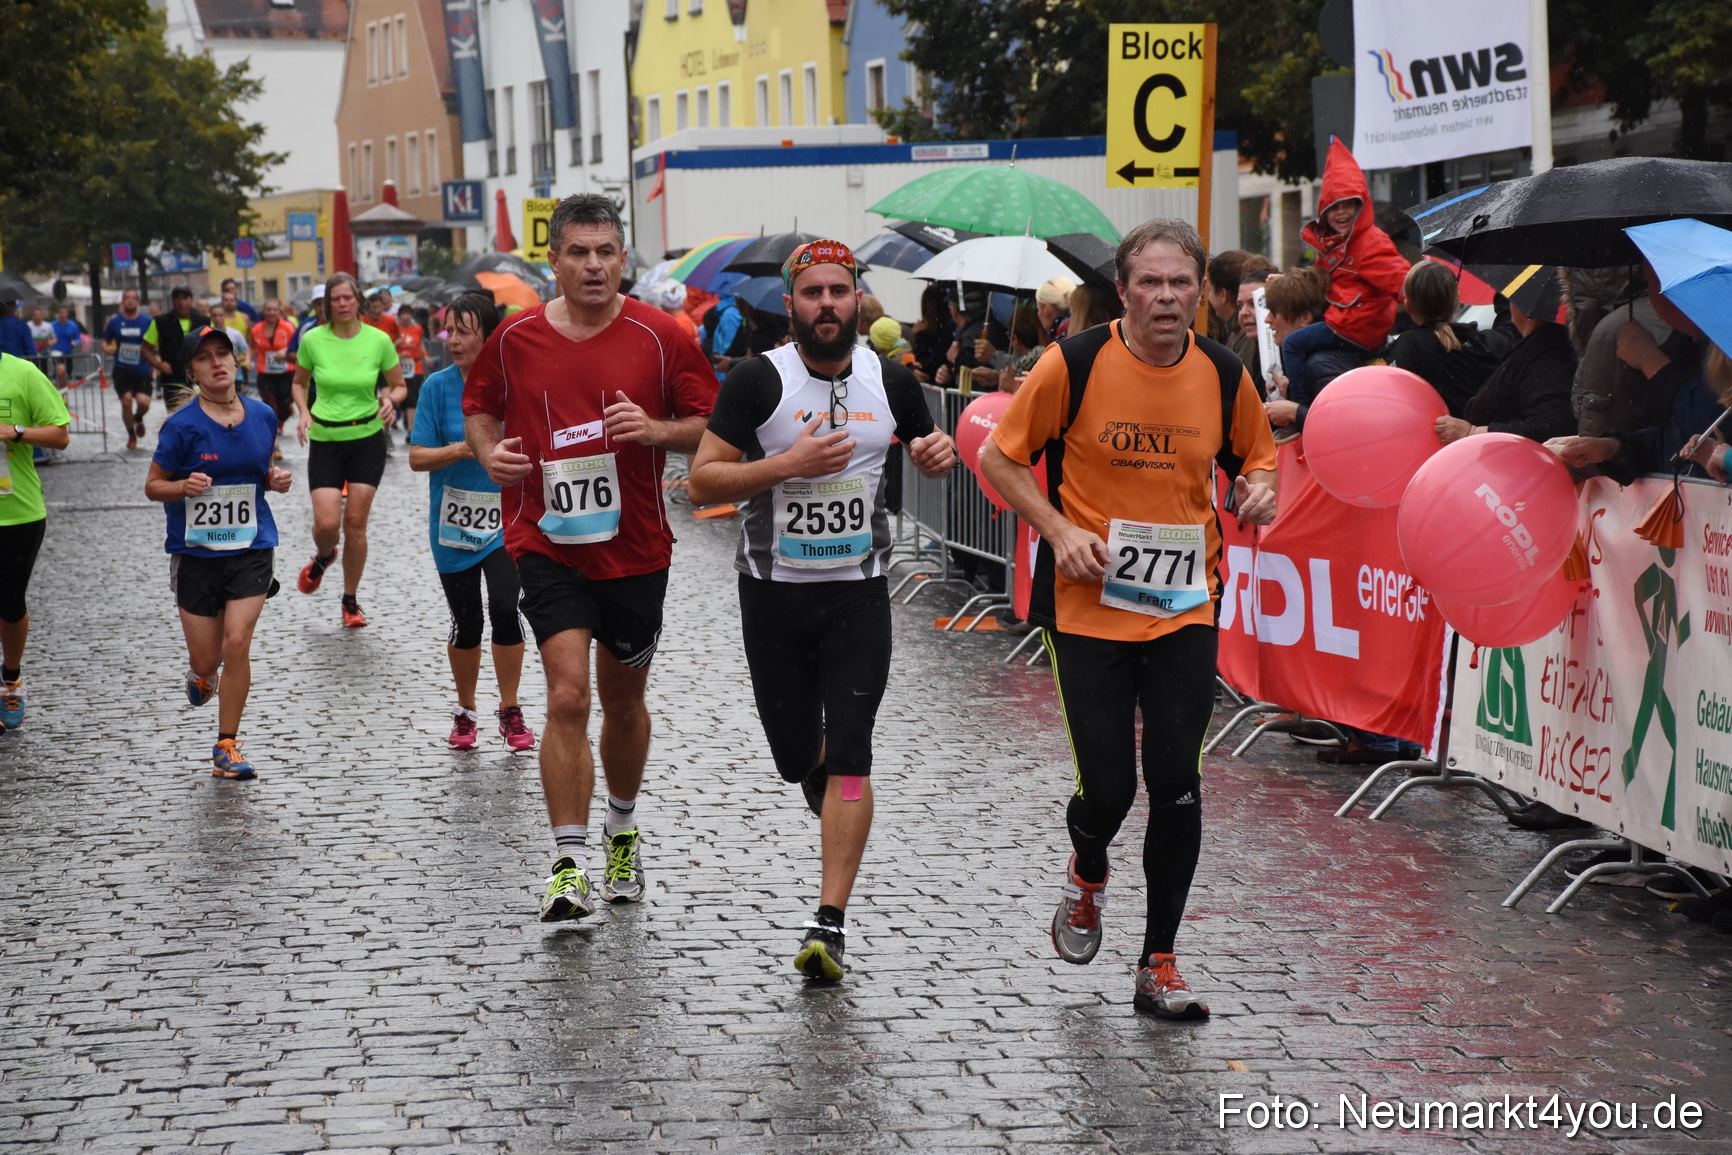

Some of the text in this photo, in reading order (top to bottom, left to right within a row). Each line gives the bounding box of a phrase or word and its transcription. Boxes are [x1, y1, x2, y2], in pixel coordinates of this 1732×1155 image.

[1122, 31, 1203, 60] Block
[1133, 73, 1187, 153] C
[533, 218, 550, 247] D
[565, 429, 589, 441] DEHN
[1112, 431, 1177, 455] OEXL
[562, 458, 608, 473] BOCK
[1110, 459, 1175, 470] CIBA VISION
[818, 478, 863, 493] BOCK
[194, 500, 250, 526] 2316
[446, 502, 501, 530] 2329
[786, 498, 865, 535] 2539
[207, 531, 236, 542] Nicole
[460, 531, 482, 544] Petra
[1118, 531, 1152, 540] NeuerMarkt
[1158, 528, 1200, 540] BOCK
[801, 543, 852, 557] Thomas
[1116, 545, 1196, 586] 2771
[1138, 592, 1174, 609] Franz
